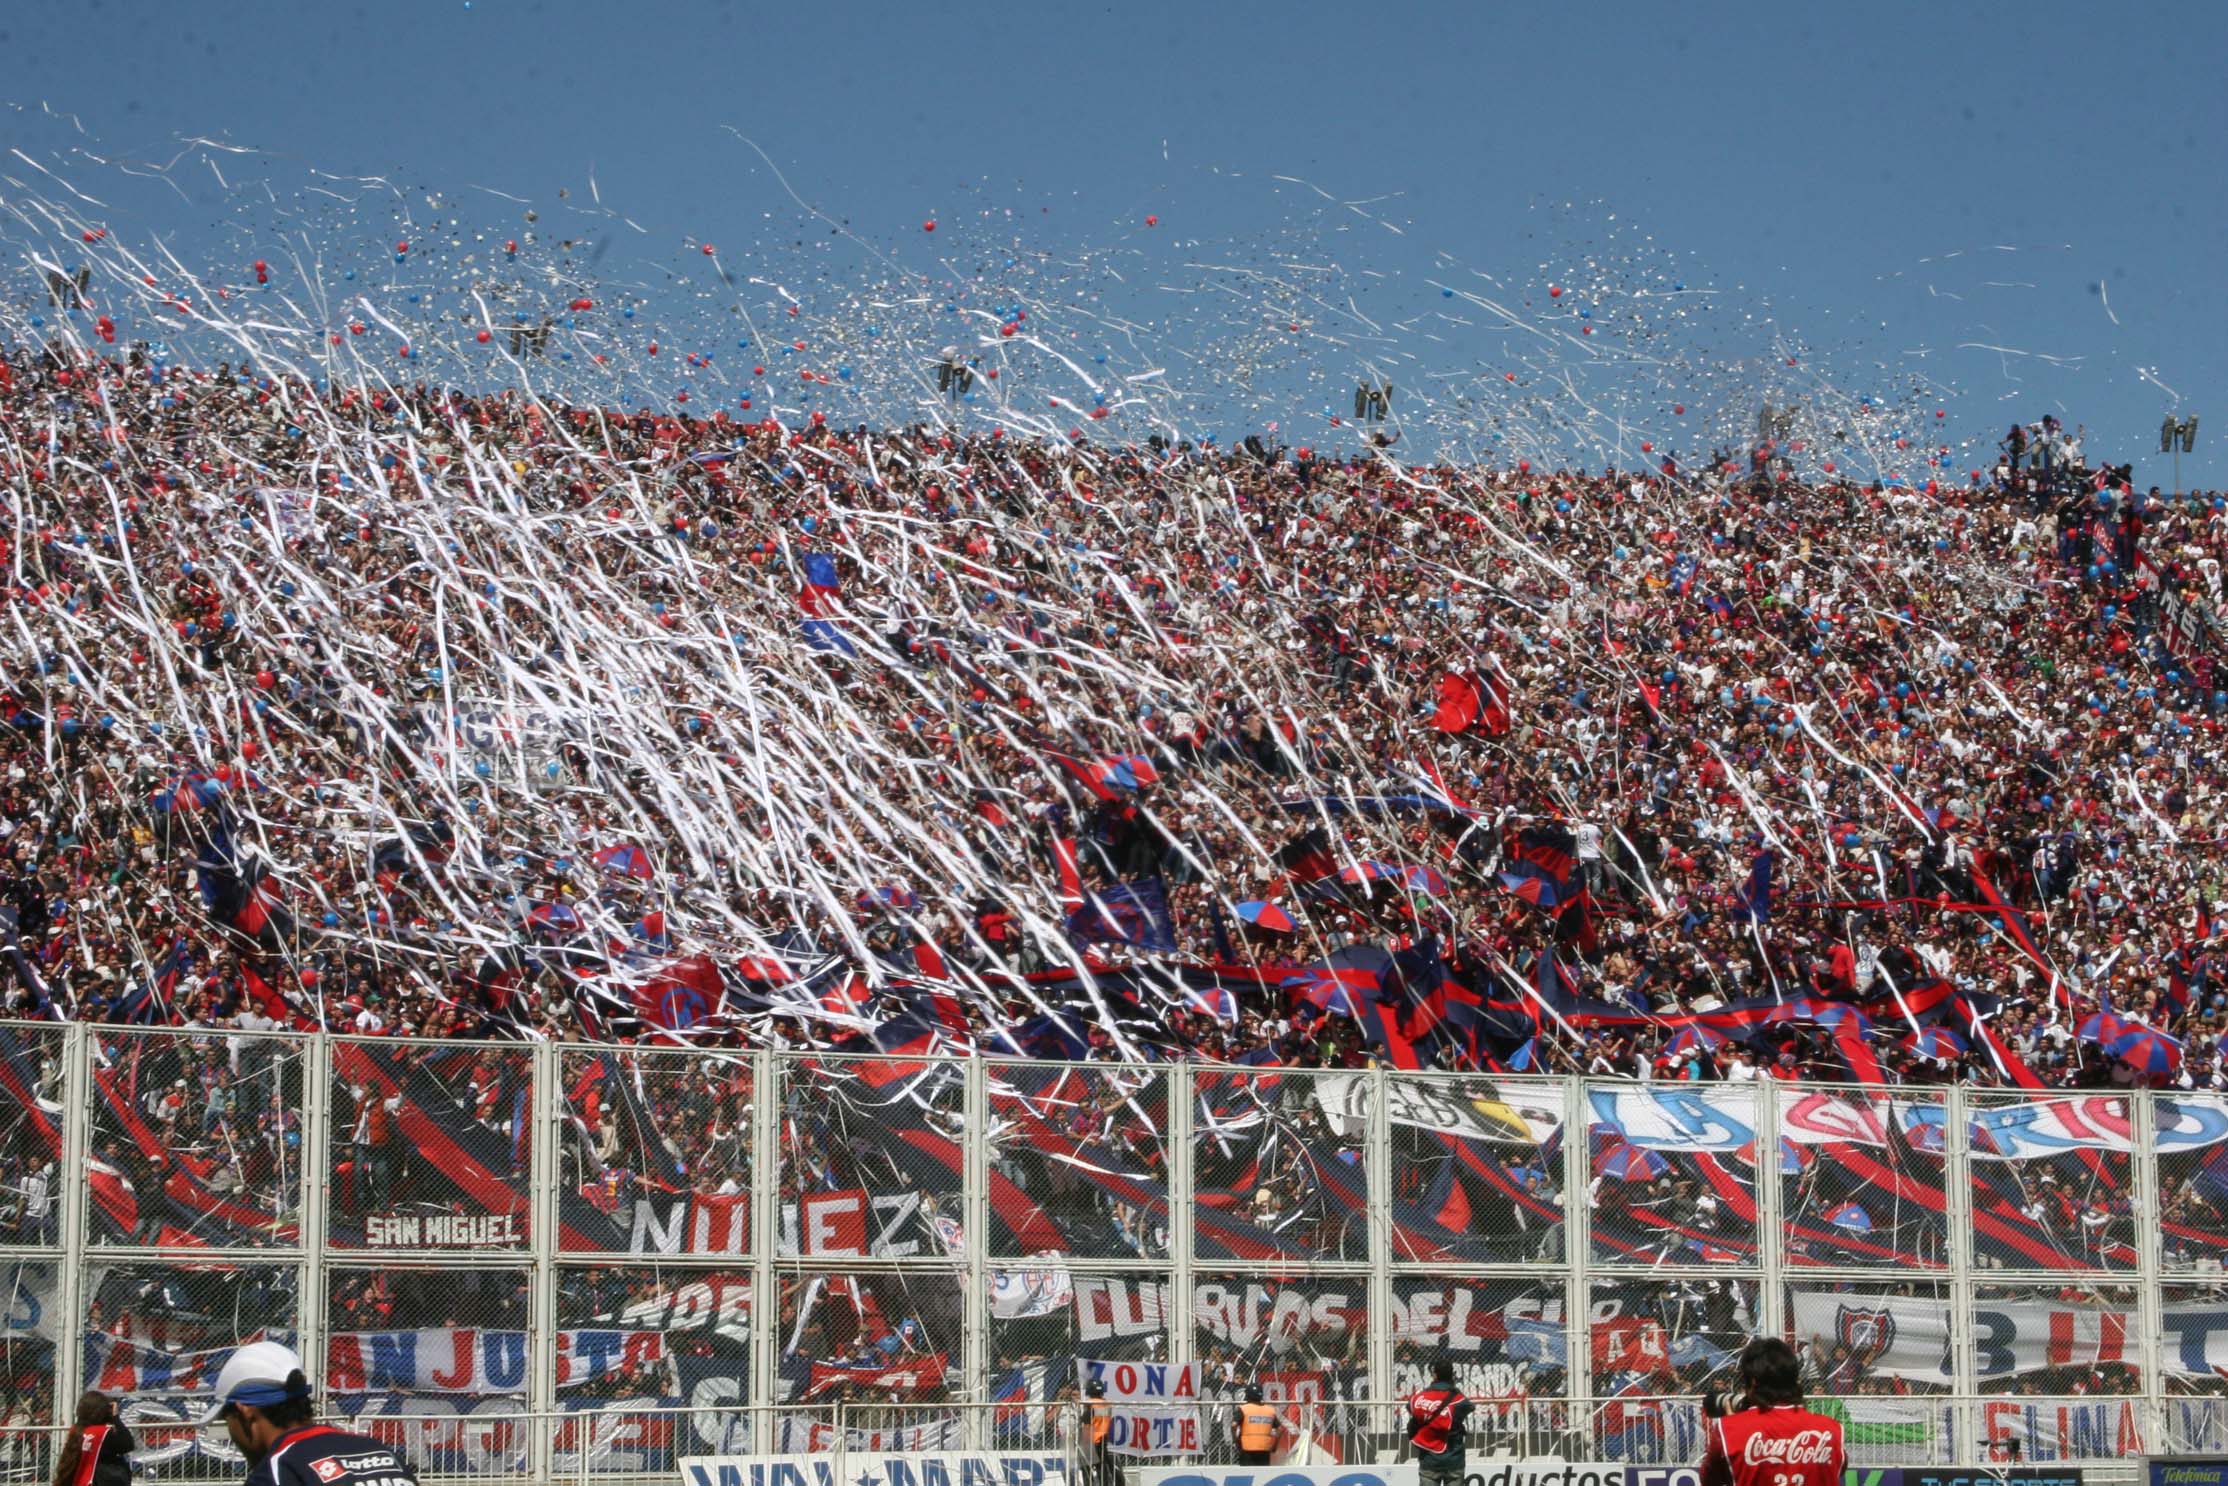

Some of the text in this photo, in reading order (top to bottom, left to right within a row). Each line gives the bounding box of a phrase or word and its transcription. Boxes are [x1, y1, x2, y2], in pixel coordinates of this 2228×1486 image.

[366, 1215, 522, 1244] SAN MIGUEL
[1087, 1362, 1195, 1396] ZONA
[1108, 1415, 1198, 1450] ORTE
[1744, 1430, 1833, 1466] Coca-Cola
[1984, 1400, 2145, 1461] ELINA
